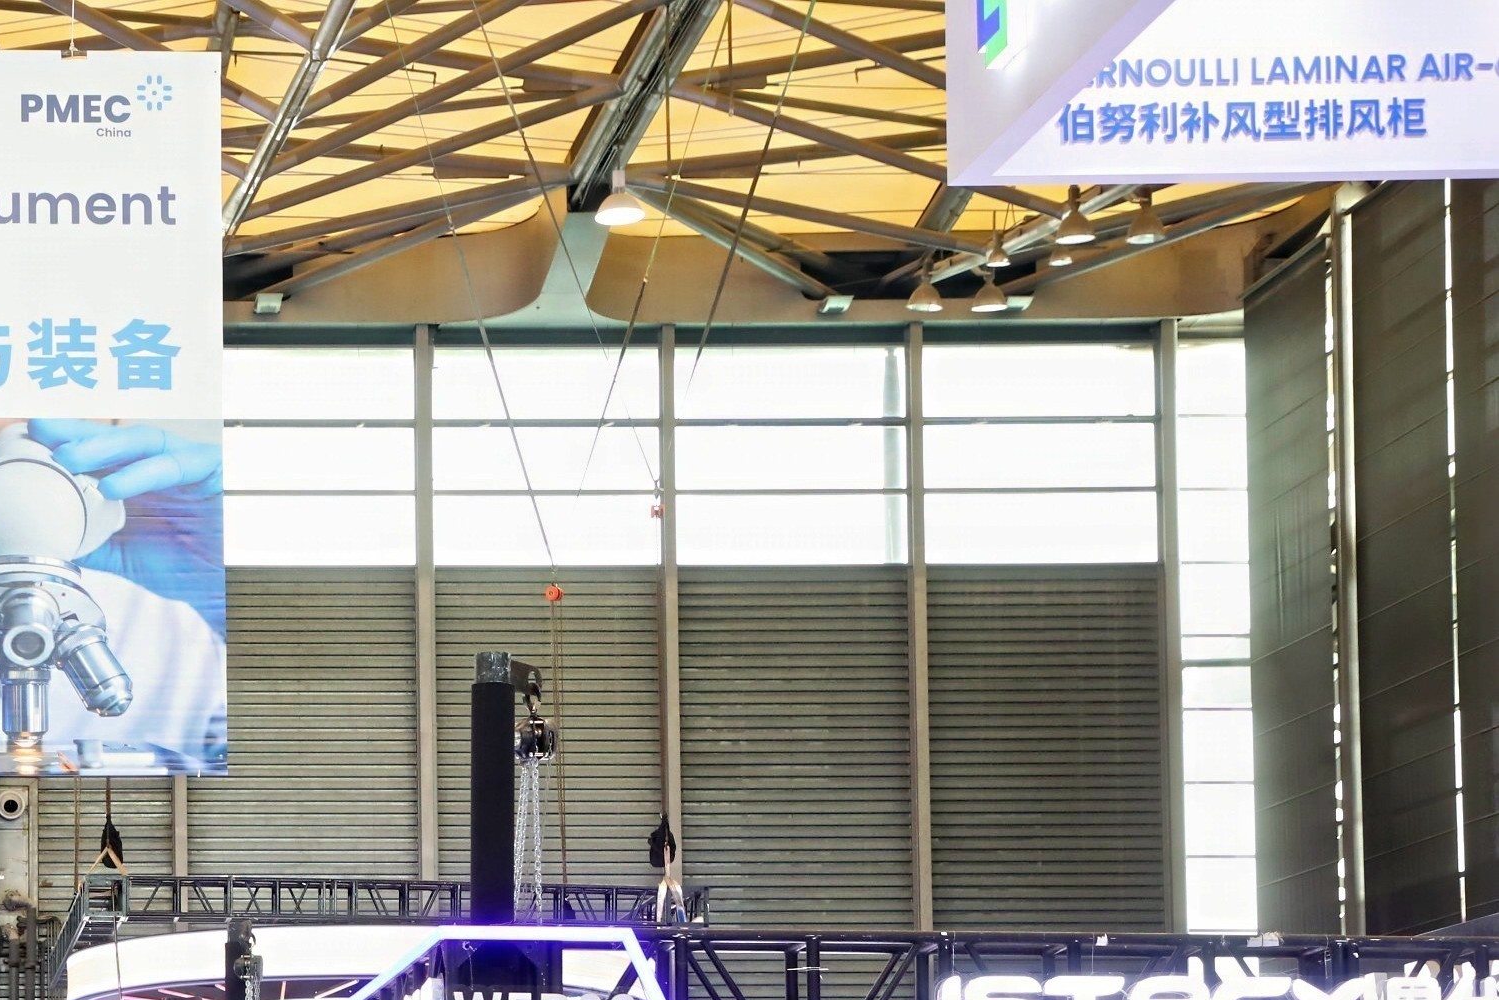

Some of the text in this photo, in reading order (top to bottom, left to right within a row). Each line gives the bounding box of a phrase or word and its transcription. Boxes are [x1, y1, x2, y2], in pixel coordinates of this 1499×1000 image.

[1085, 52, 1499, 88] RNOULLI LAMINAR AIR-
[20, 94, 131, 124] PMEC
[1056, 98, 1427, 143] 伯努利补风型排风柜
[96, 127, 132, 138] China
